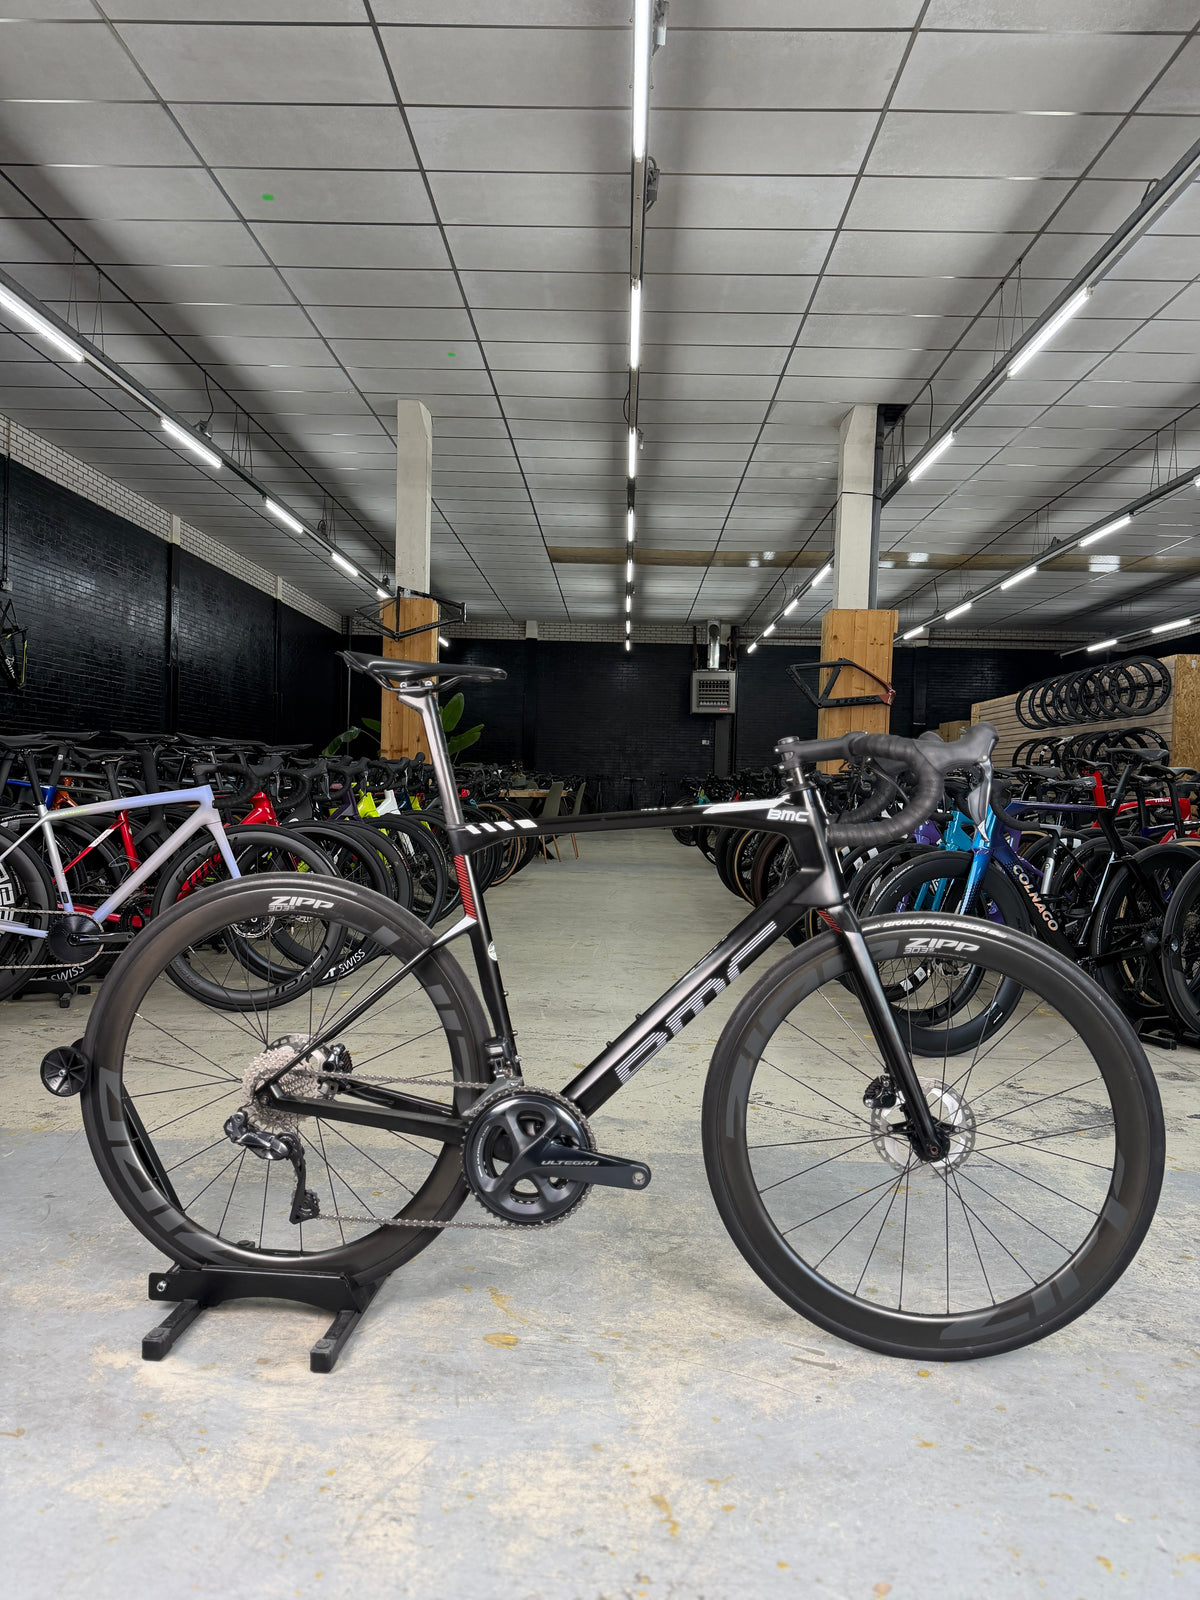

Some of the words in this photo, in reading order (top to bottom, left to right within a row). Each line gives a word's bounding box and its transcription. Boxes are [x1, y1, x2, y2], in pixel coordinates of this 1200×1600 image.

[766, 808, 810, 823] BMC
[268, 896, 335, 909] ZIPP
[1013, 864, 1059, 932] COLNAGO
[882, 919, 925, 928] GRAND
[923, 919, 954, 927] PRIX
[905, 937, 981, 952] ZIPP
[337, 948, 367, 973] SWISS
[540, 1159, 600, 1167] ULTEGRA
